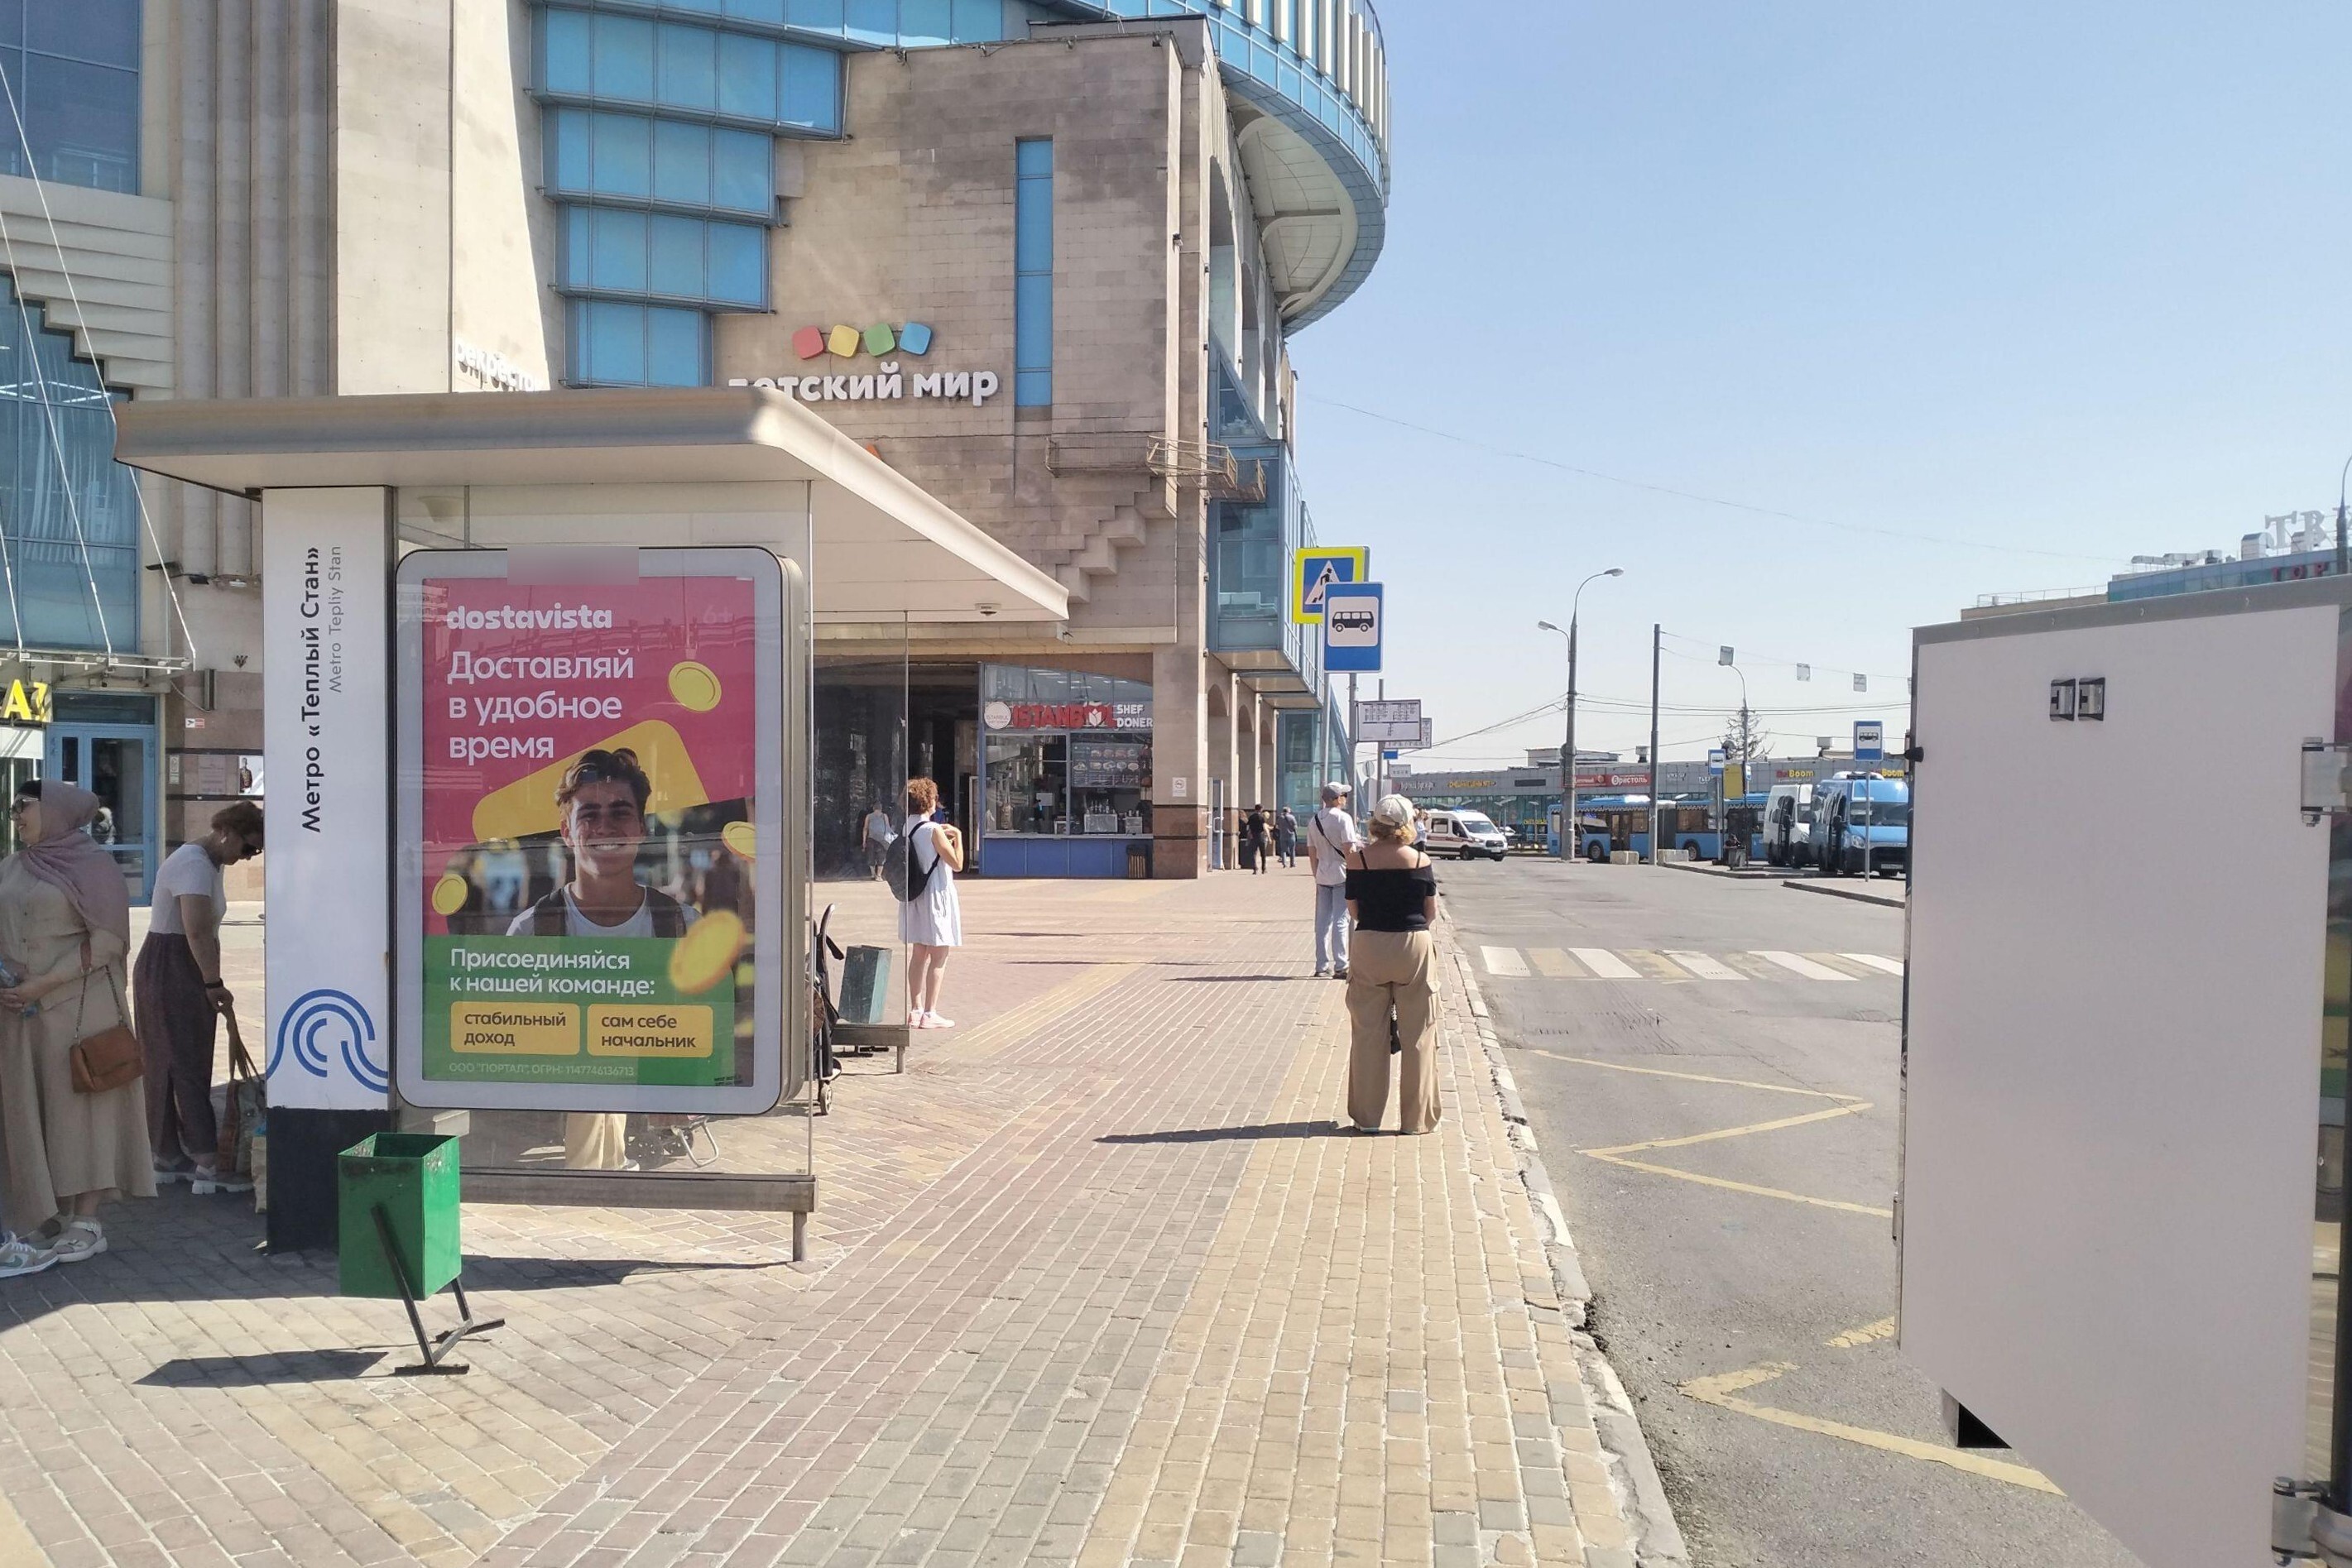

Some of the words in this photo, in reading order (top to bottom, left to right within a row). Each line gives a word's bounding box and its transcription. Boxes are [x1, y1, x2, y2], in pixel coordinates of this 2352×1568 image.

[728, 361, 903, 401] тский
[913, 370, 999, 407] мир
[329, 546, 341, 581] Stan
[300, 547, 319, 618] Стан»
[329, 587, 344, 635] Tepliy
[447, 603, 612, 630] dostavista
[329, 642, 342, 693] Metro
[447, 648, 634, 684] Доставляй
[300, 628, 320, 736] «Теплый
[449, 697, 466, 718] в
[473, 690, 622, 725] удобное
[1116, 704, 1144, 714] SHEF
[1116, 717, 1153, 728] DONER
[449, 736, 554, 765] время
[301, 746, 324, 832] Метро
[450, 947, 630, 971] Присоединяйся
[450, 977, 462, 991] к
[466, 974, 543, 993] нашей
[548, 979, 655, 998] команде:
[463, 1012, 567, 1027] стабильный
[602, 1016, 634, 1028] сам
[638, 1014, 678, 1029] себе
[463, 1032, 516, 1047] доход
[602, 1033, 696, 1048] начальник
[449, 1062, 474, 1072] ООО
